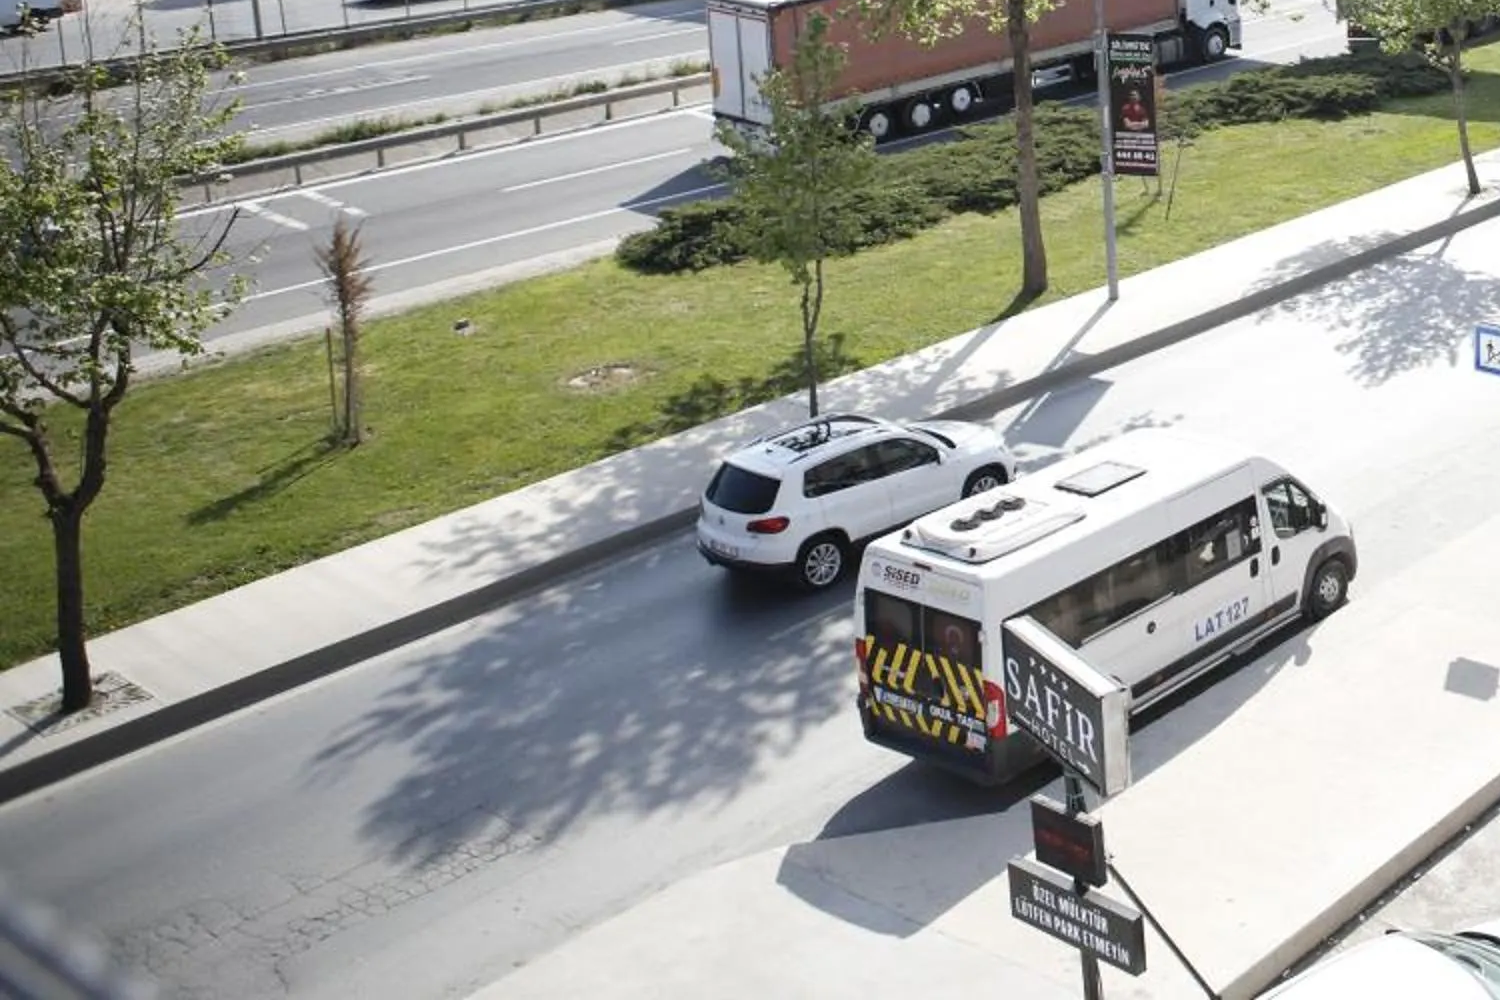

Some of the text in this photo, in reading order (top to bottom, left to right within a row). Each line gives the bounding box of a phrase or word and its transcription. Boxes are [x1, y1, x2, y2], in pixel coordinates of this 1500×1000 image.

[1030, 719, 1078, 766] HOTEL
[1015, 893, 1131, 967] LÜTFEN PARK ETMEYİN
[1031, 877, 1109, 936] ÖZEL MÜLKTÜR
